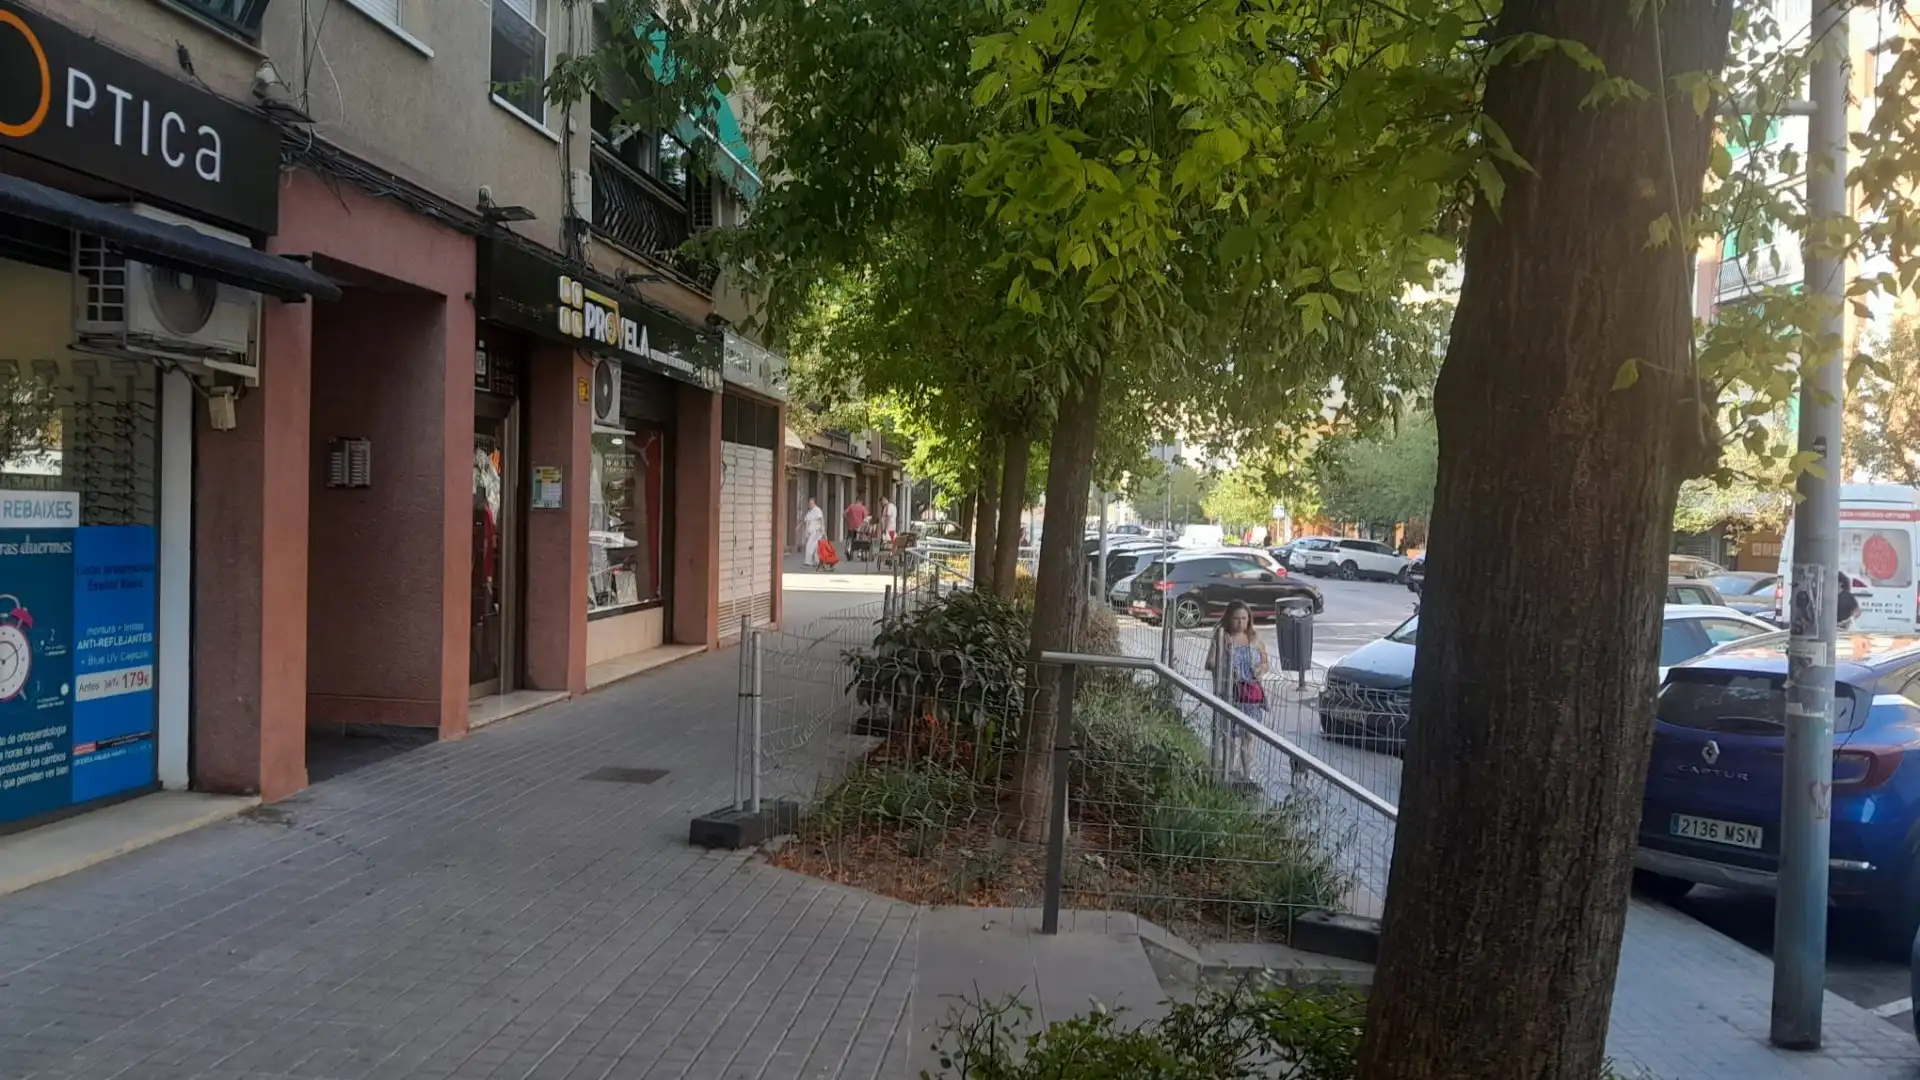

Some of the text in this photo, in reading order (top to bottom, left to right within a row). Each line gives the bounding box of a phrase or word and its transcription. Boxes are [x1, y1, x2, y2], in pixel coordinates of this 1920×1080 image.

[584, 301, 650, 358] PROVELA
[3, 499, 73, 519] REBAIXES
[20, 534, 73, 554] duermes
[77, 632, 153, 650] ANTI-REFLEJANTES
[79, 681, 100, 692] Antes
[122, 669, 149, 688] 179€
[5, 748, 24, 759] horas
[24, 744, 33, 755] de
[31, 757, 40, 768] los
[41, 752, 67, 765] cambios
[3, 778, 16, 789] que
[17, 771, 45, 787] permiten
[56, 765, 69, 776] bien
[1678, 764, 1748, 780] CAPTUR
[1681, 818, 1757, 845] 2136 MSN
